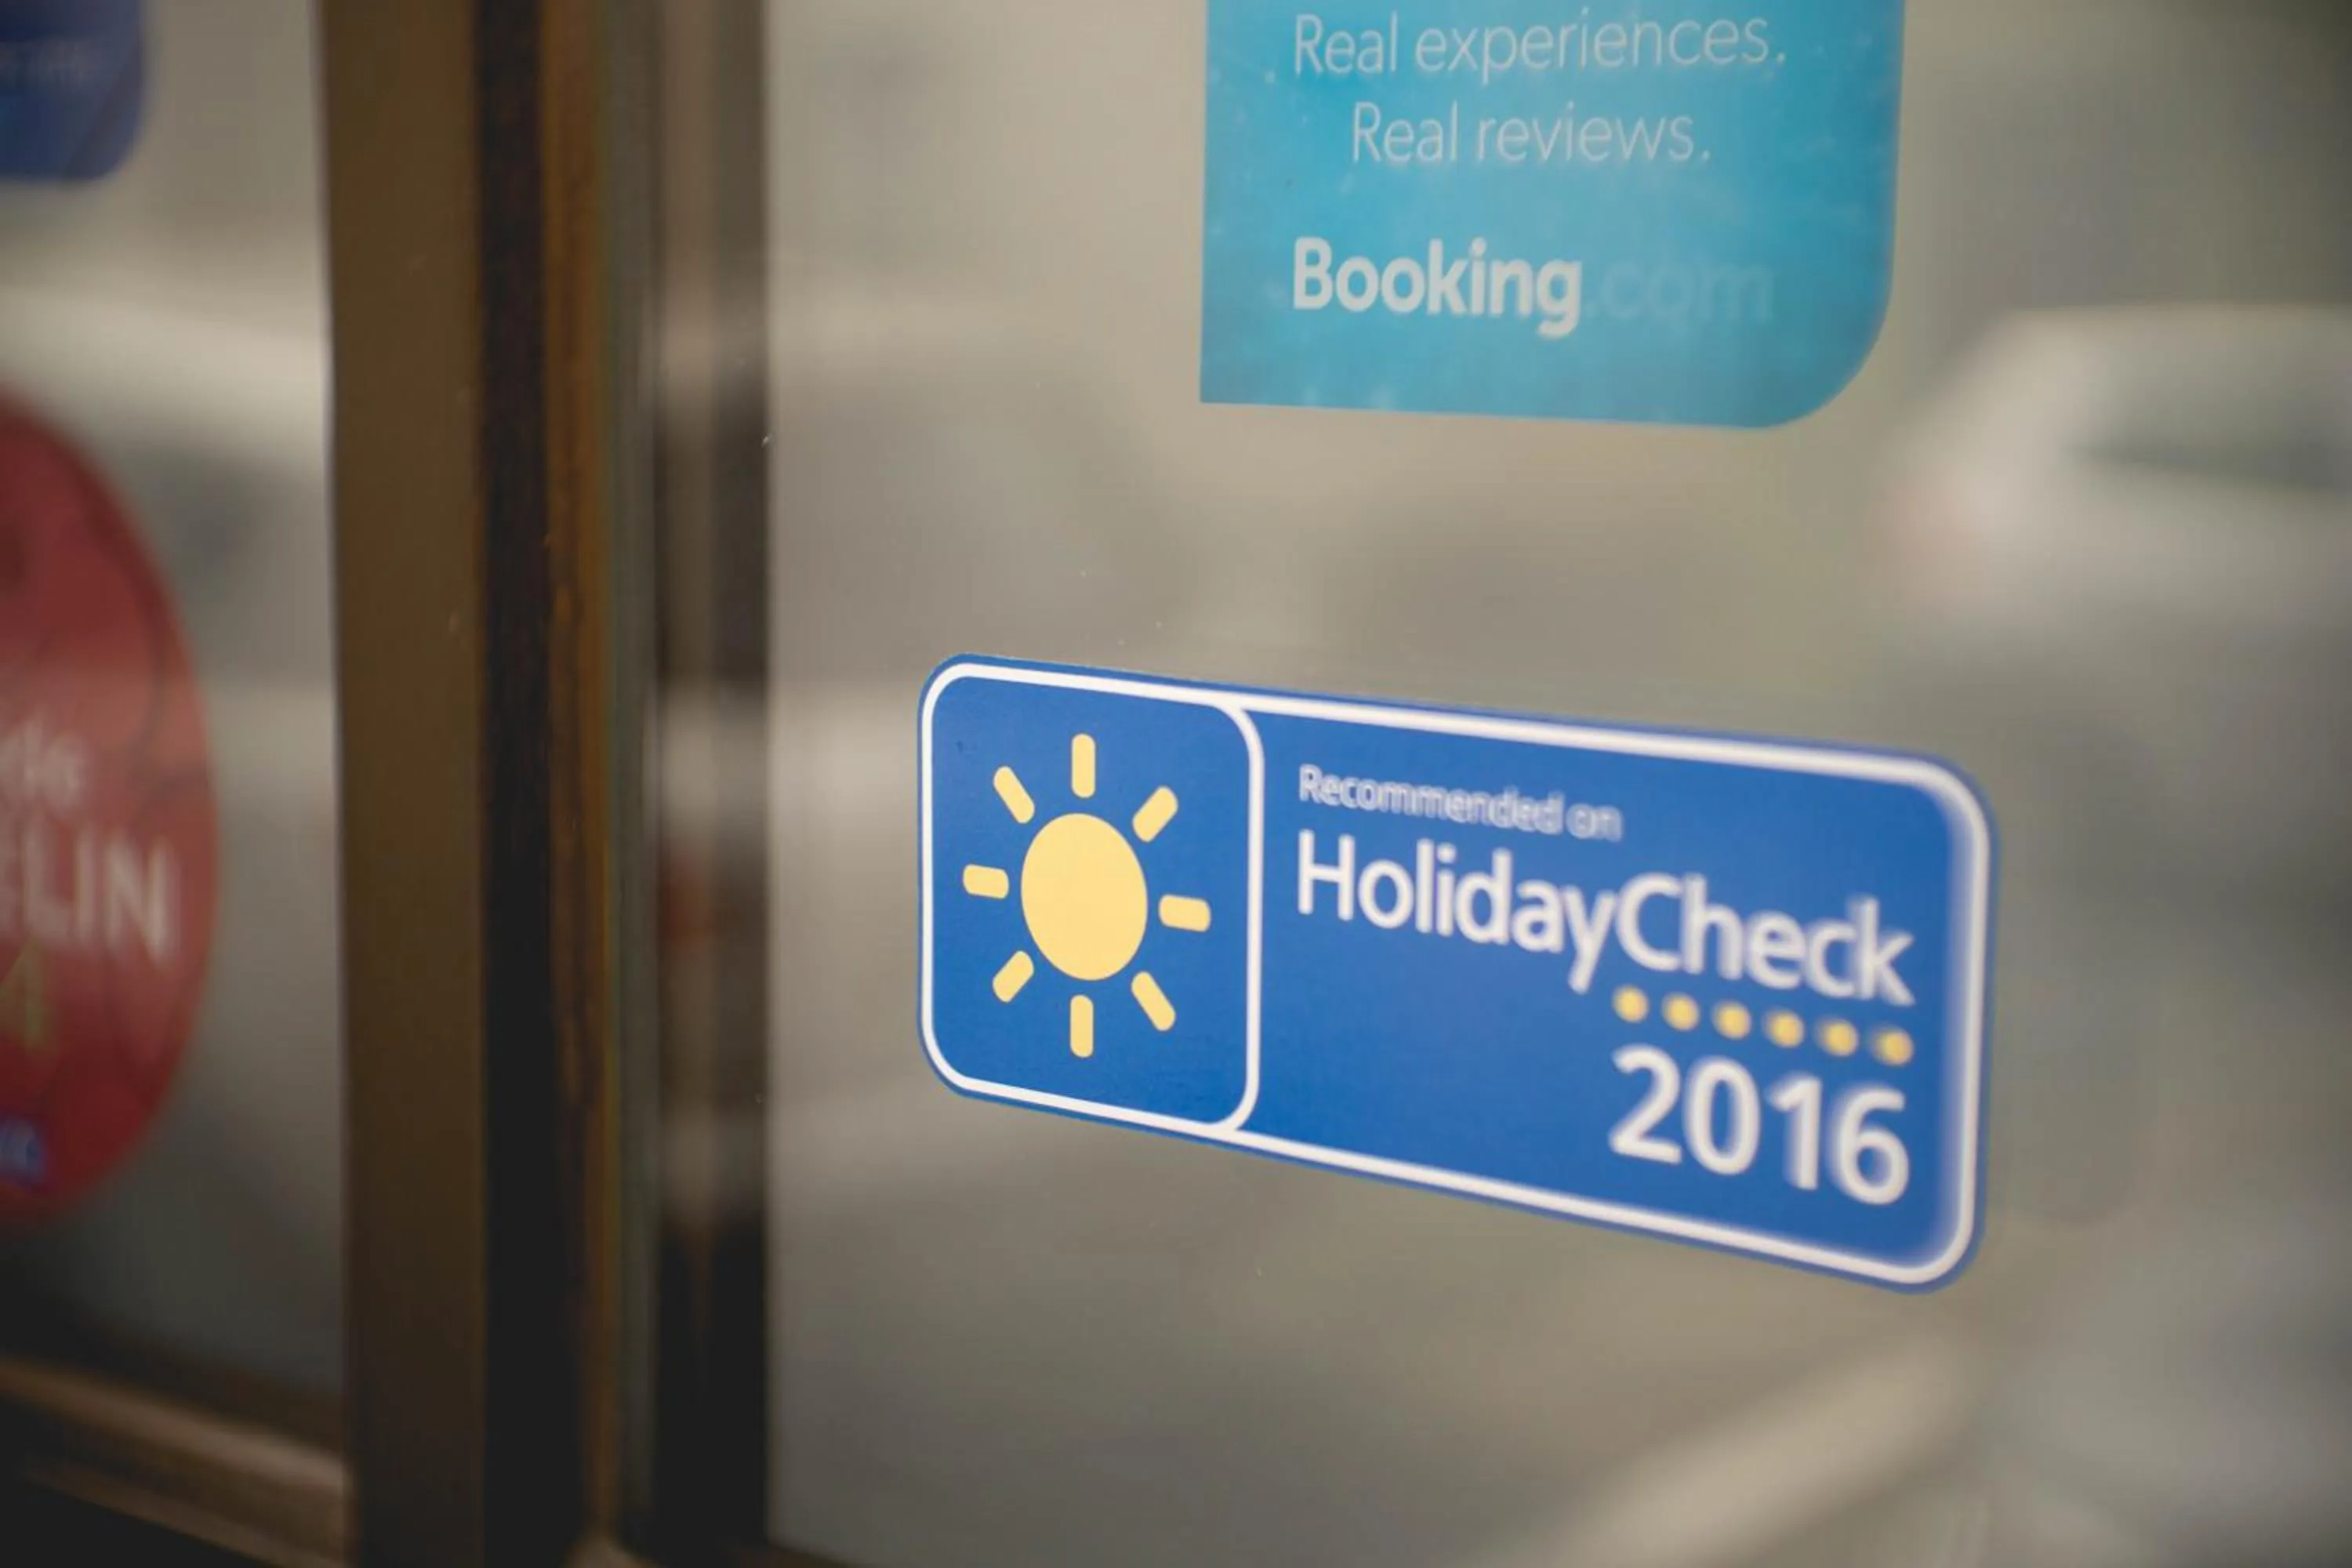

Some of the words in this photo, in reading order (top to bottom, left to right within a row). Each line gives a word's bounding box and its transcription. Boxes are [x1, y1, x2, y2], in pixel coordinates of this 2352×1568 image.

[1294, 13, 1398, 75] Real
[1414, 8, 1788, 84] experiences.
[1352, 100, 1459, 163] Real
[1477, 101, 1712, 163] reviews.
[1299, 763, 1564, 836] Recommended
[1566, 795, 1624, 842] on
[0, 811, 179, 966] LIN
[1297, 829, 1916, 1008] HolidayCheck
[1607, 1043, 1911, 1207] 2016
